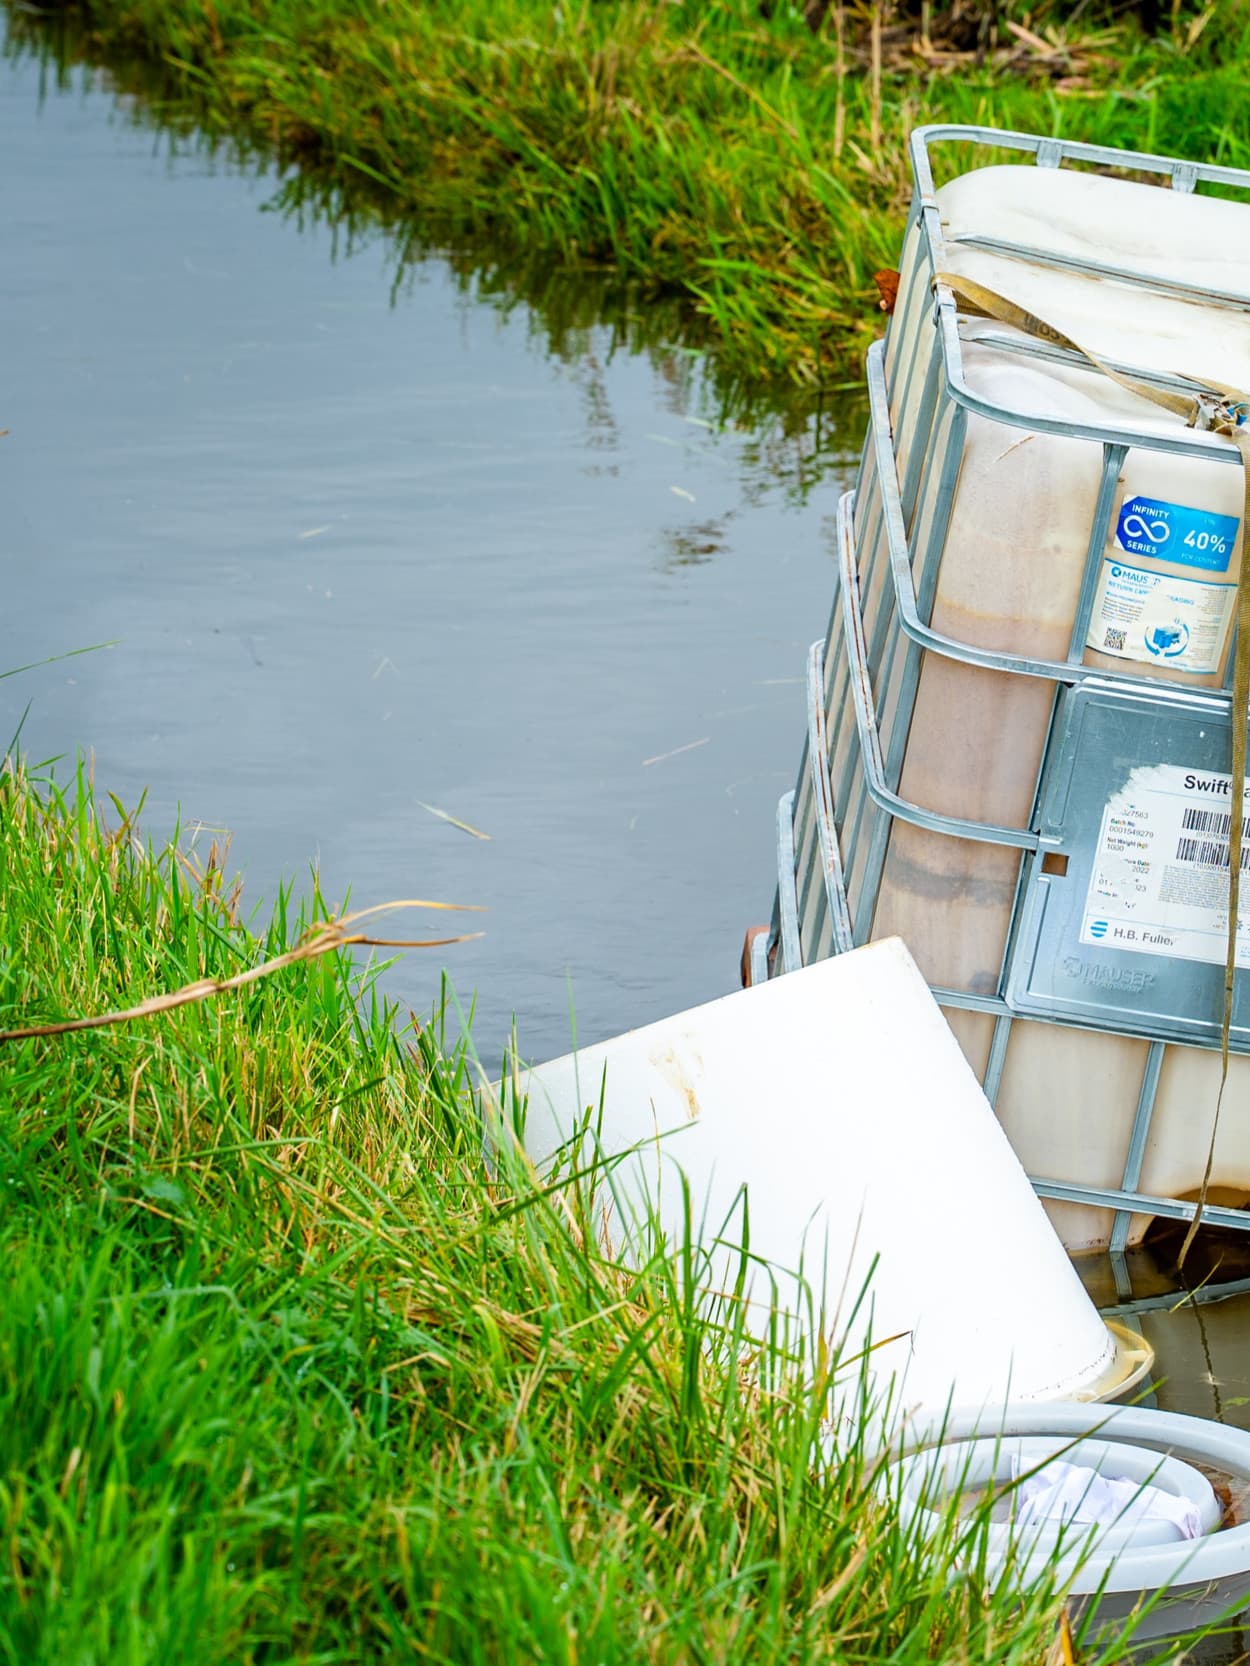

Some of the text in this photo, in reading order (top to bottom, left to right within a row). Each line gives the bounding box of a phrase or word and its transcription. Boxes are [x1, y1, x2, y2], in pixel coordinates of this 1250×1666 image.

[1132, 504, 1170, 519] INFINITY
[1126, 539, 1157, 554] SERIES
[1183, 529, 1226, 554] 40%
[1122, 569, 1161, 585] MAUSR
[1113, 927, 1138, 942] H.B.
